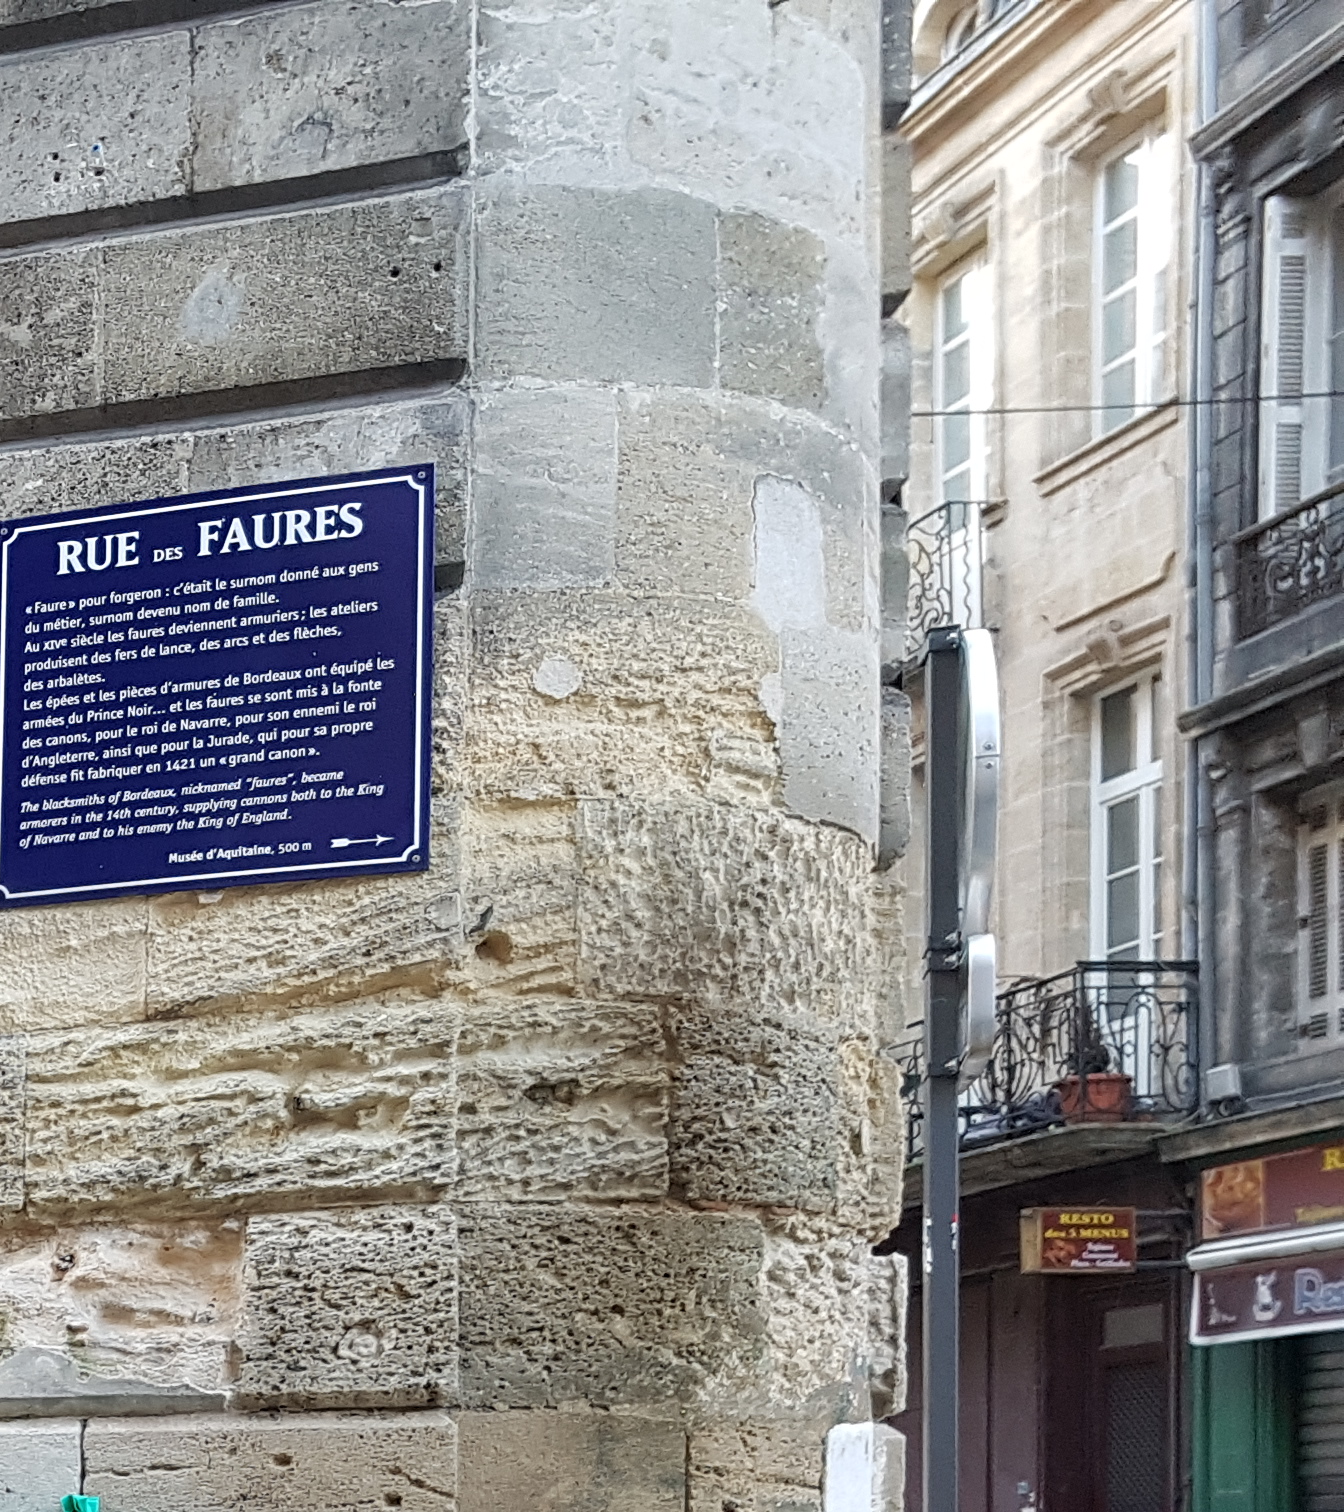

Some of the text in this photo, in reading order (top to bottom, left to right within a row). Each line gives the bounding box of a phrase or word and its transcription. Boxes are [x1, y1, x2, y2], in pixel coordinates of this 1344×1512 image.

[56, 502, 363, 575] RUE DES FAURES
[78, 595, 106, 610] pour
[109, 588, 161, 604] forgeron
[173, 579, 212, 595] c'était
[215, 578, 226, 590] le
[229, 574, 275, 588] surnom
[279, 565, 319, 582] donné
[322, 566, 345, 577] aux
[348, 561, 378, 576] gens
[24, 591, 279, 634] du métier, surnom devenu nom de famille.
[24, 641, 39, 653] Au
[70, 632, 104, 647] siècle
[107, 630, 124, 642] les
[127, 626, 164, 640] faures
[168, 616, 236, 635] deviennent
[309, 605, 327, 618] les
[330, 600, 378, 615] ateliers
[24, 624, 341, 675] produisent des fers de lance, des arcs et des flèches,
[168, 842, 311, 863] Musée d'Aquitaine, 500 m
[1060, 1213, 1114, 1225] RESTO
[1080, 1228, 1129, 1239] MENUS
